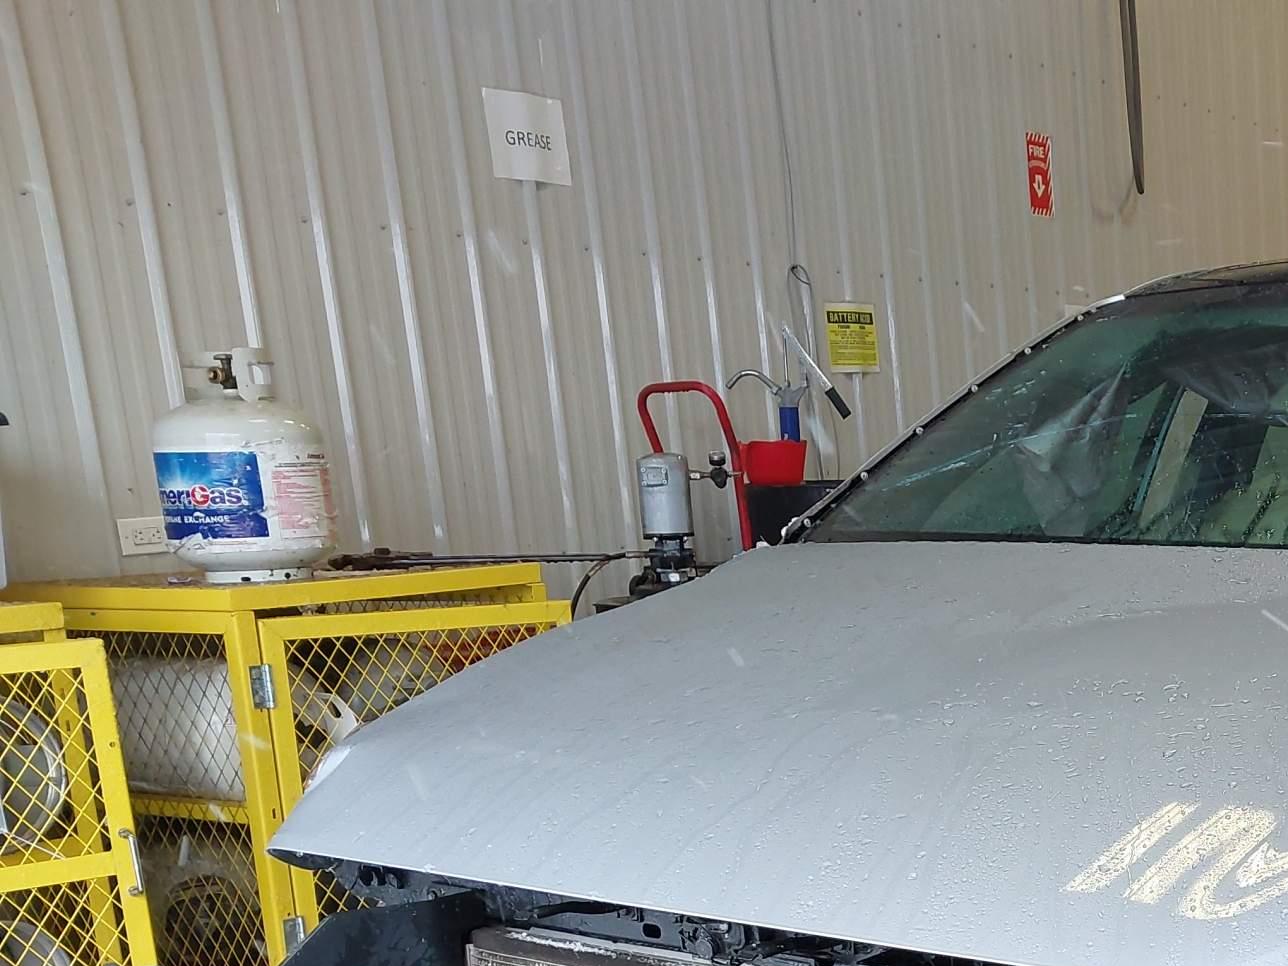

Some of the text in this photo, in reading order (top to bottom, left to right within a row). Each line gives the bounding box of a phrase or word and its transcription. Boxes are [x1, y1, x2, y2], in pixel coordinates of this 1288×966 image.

[505, 130, 552, 151] GREASE
[1028, 144, 1046, 159] FIRE
[829, 312, 859, 323] BATTERY
